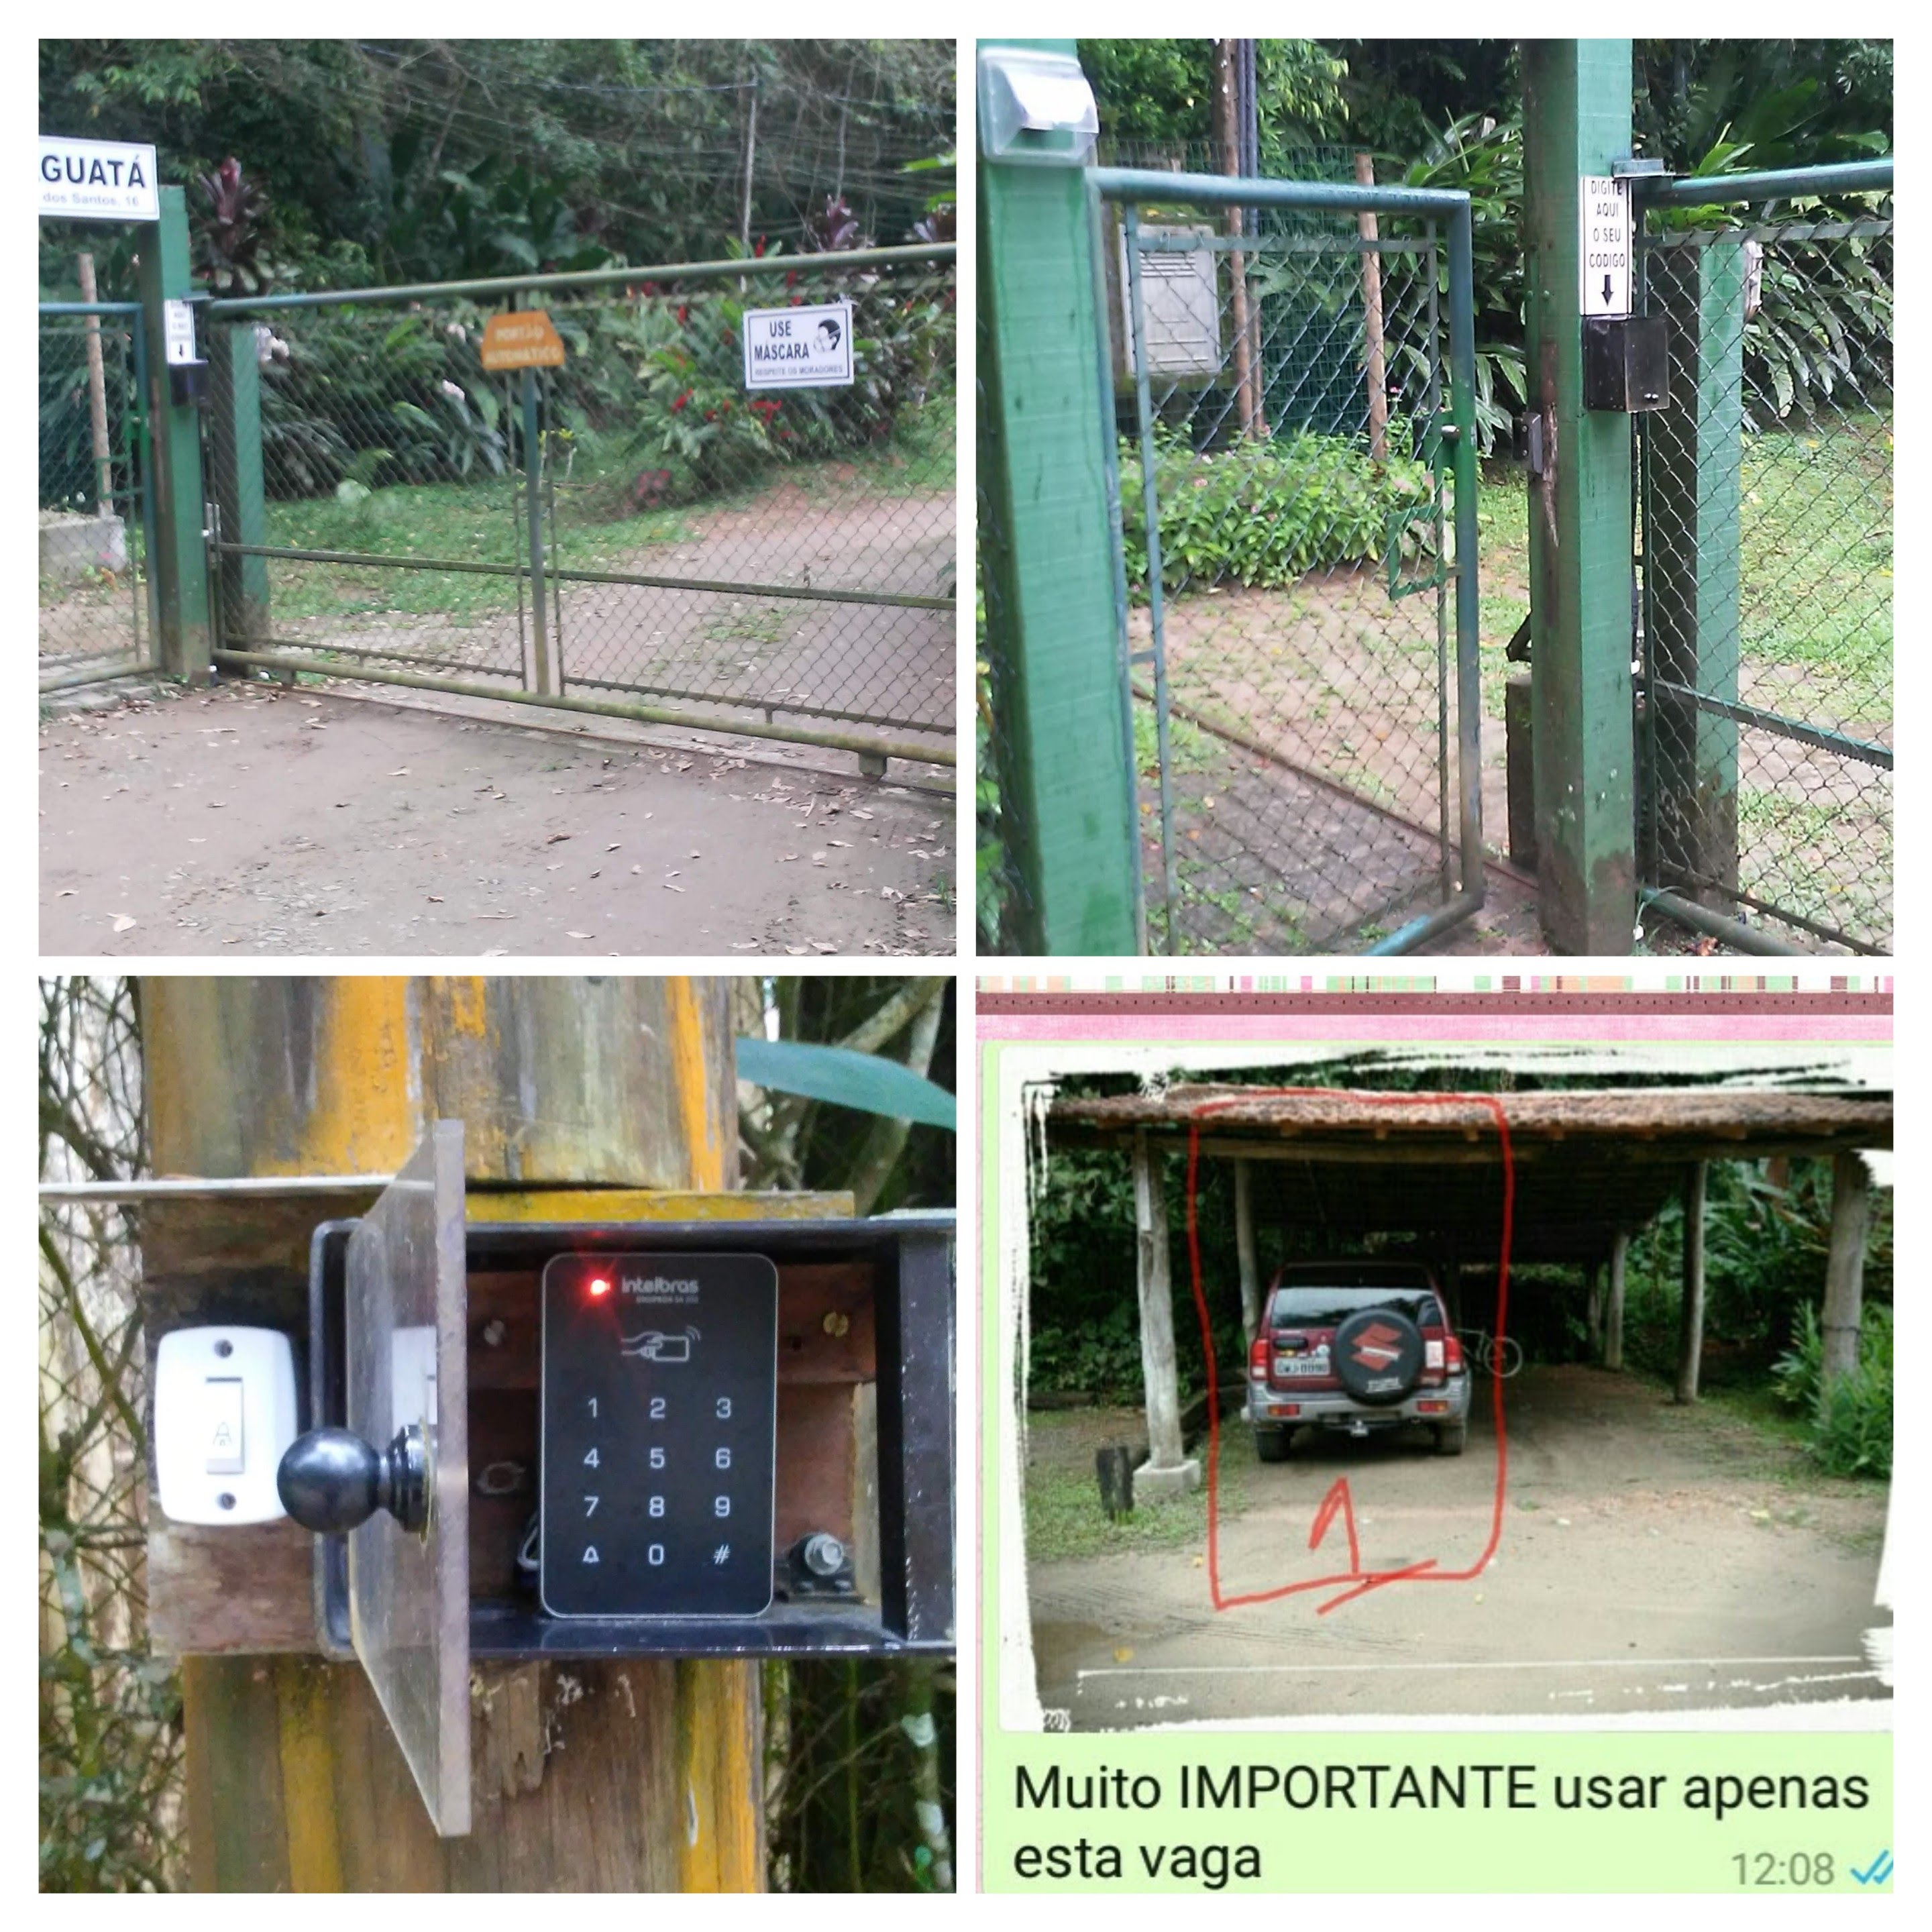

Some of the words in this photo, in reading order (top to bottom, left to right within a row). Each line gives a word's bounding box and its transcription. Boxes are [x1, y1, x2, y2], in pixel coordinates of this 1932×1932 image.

[39, 154, 146, 188] GUATÁ
[43, 192, 67, 203] dos
[1591, 180, 1623, 195] DIGITE
[1597, 203, 1619, 217] AQUI
[1593, 228, 1599, 242] O
[1603, 227, 1621, 242] SEU
[1589, 253, 1625, 268] CODIGO
[769, 321, 792, 337] USE
[755, 367, 785, 376] RESPEITE
[788, 367, 798, 375] OS
[799, 365, 843, 374] MORADORES
[621, 1276, 699, 1294] intelbras
[588, 1397, 598, 1418] 1
[650, 1397, 666, 1419] 2
[716, 1397, 732, 1419] 3
[583, 1448, 600, 1468] 4
[649, 1447, 665, 1469] 5
[715, 1447, 731, 1469] 6
[584, 1496, 599, 1517] 7
[649, 1495, 665, 1517] 8
[714, 1495, 731, 1517] 9
[648, 1544, 665, 1566] 0
[1015, 1764, 1162, 1810] Muito
[1181, 1764, 1538, 1810] IMPORTANTE
[1554, 1774, 1667, 1810] usar
[1683, 1774, 1870, 1821] apenas
[1014, 1837, 1123, 1880] esta
[1139, 1845, 1262, 1891] vaga
[1732, 1852, 1835, 1886] 12:08
